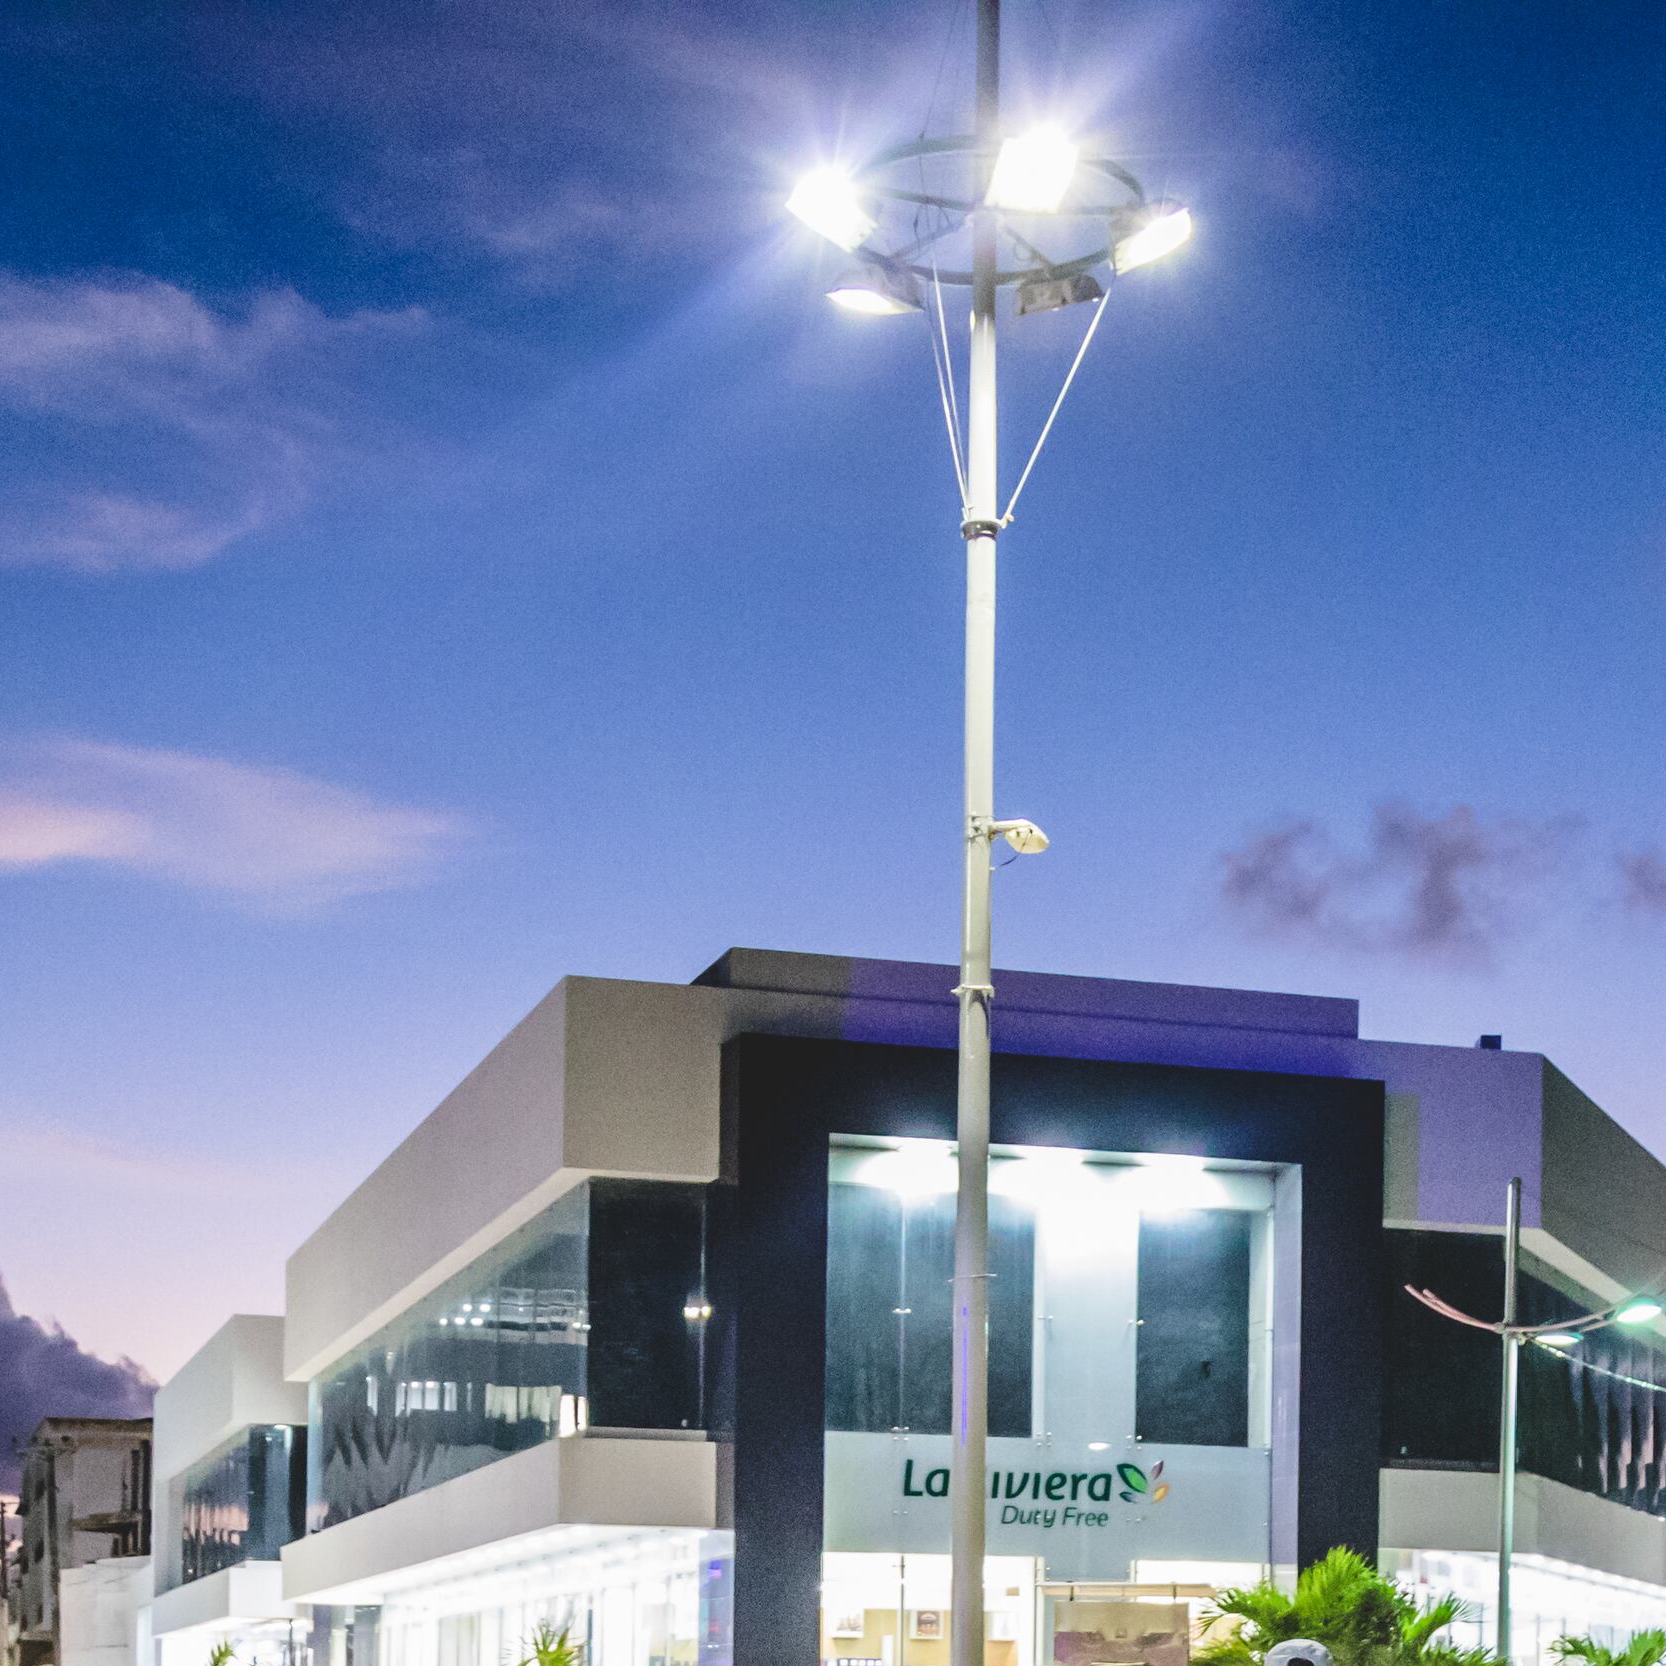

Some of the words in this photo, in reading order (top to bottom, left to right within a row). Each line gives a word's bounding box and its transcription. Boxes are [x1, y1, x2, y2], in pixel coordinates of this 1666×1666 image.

[903, 1459, 951, 1497] La
[988, 1471, 1112, 1502] iviera
[1001, 1506, 1056, 1528] Duty
[1062, 1507, 1109, 1527] Free
